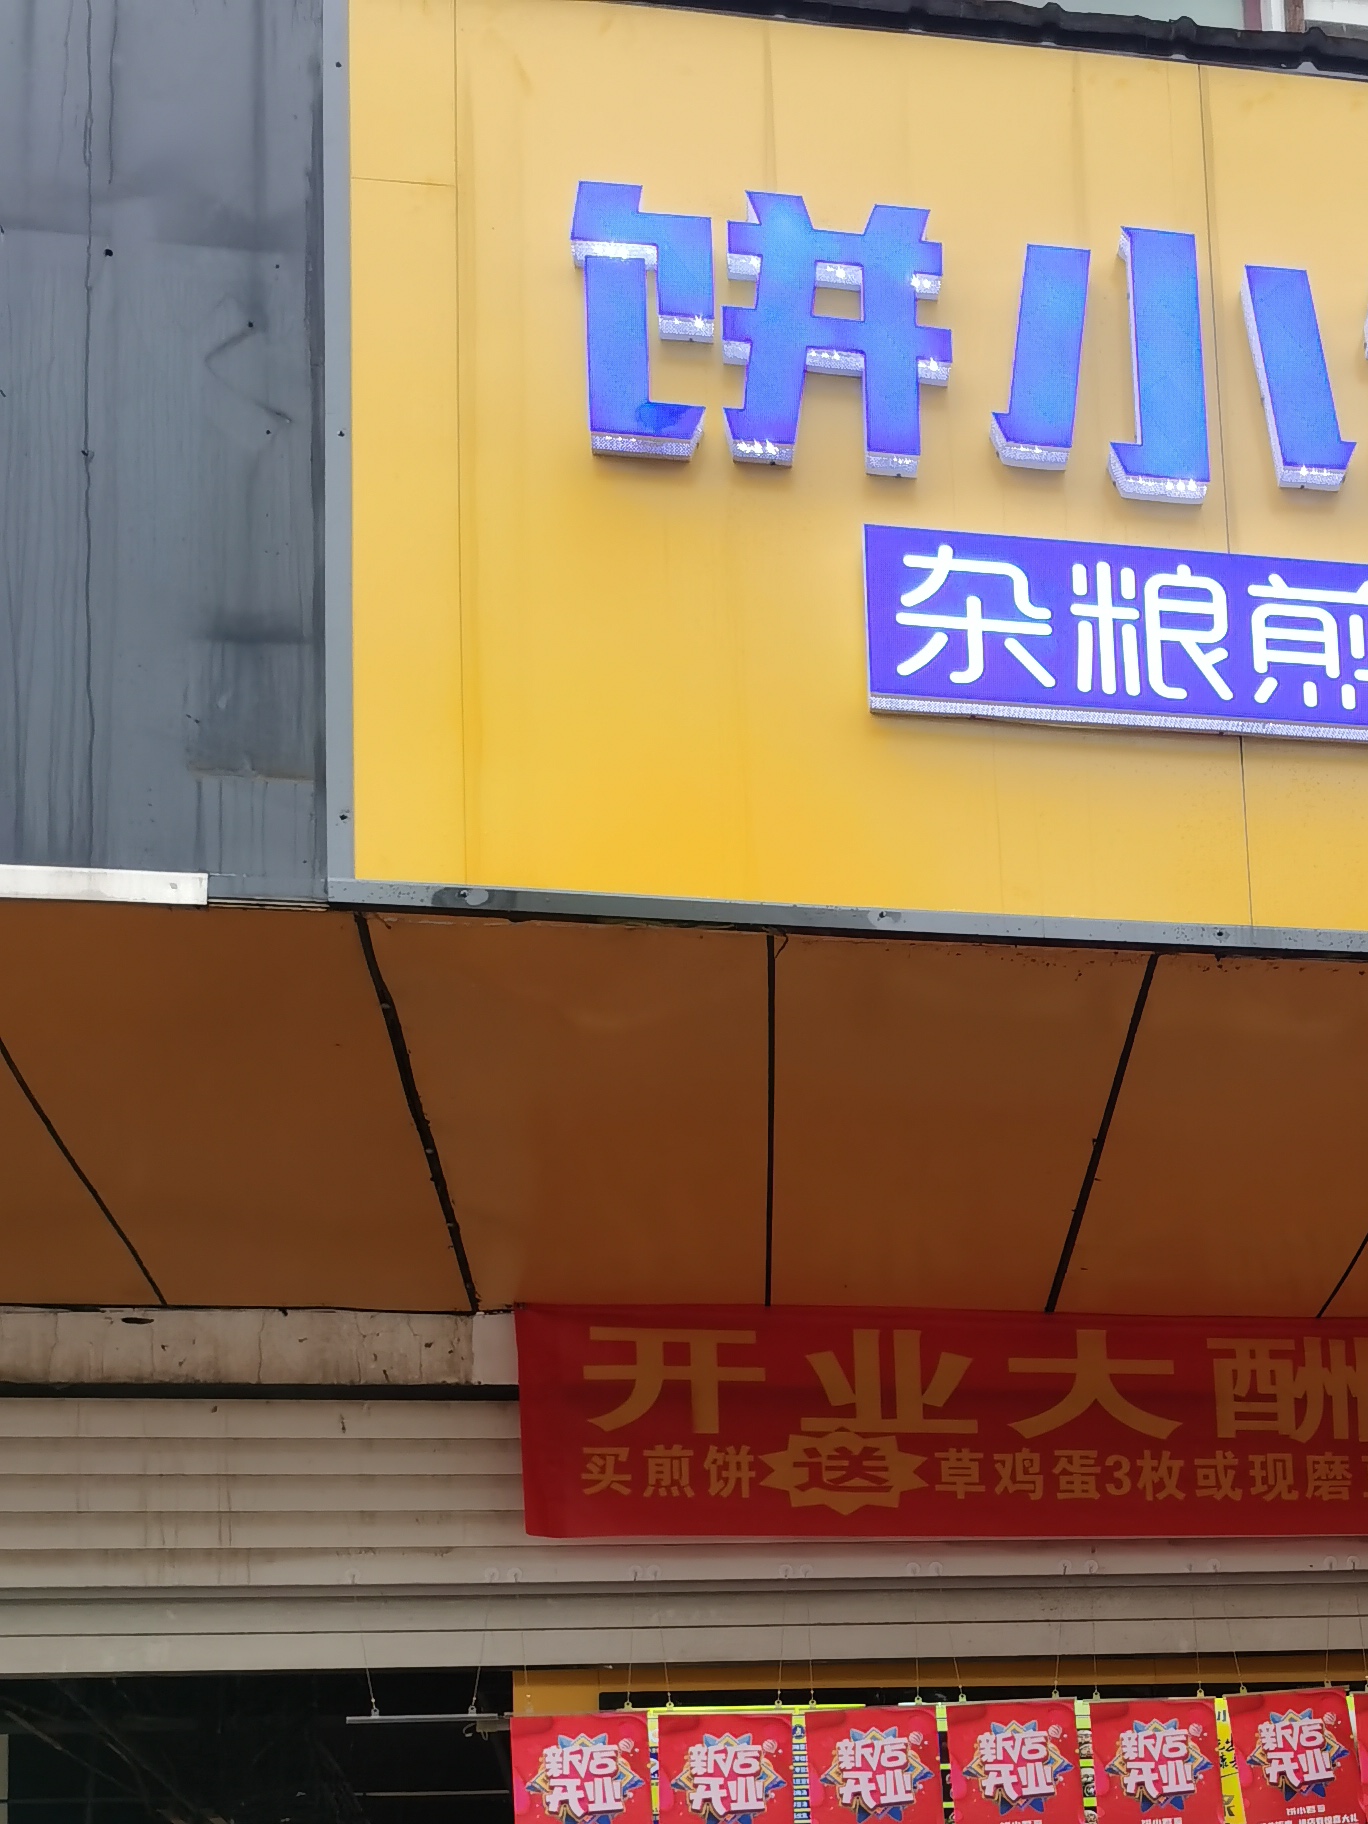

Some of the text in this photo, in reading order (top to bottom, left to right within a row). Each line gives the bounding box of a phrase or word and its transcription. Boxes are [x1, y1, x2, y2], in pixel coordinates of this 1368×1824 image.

[977, 1731, 1048, 1763] 新店
[1119, 1729, 1189, 1761] 新店
[1258, 1719, 1324, 1751] 新店
[543, 1744, 618, 1778] 新店
[689, 1745, 762, 1777] 新店
[836, 1737, 908, 1770] 新店
[1265, 1750, 1335, 1788] 开业
[546, 1777, 624, 1816] 开业
[690, 1777, 765, 1815] 开业
[839, 1770, 914, 1808] 开业
[982, 1762, 1055, 1800] 开业
[1123, 1761, 1195, 1799] 开业
